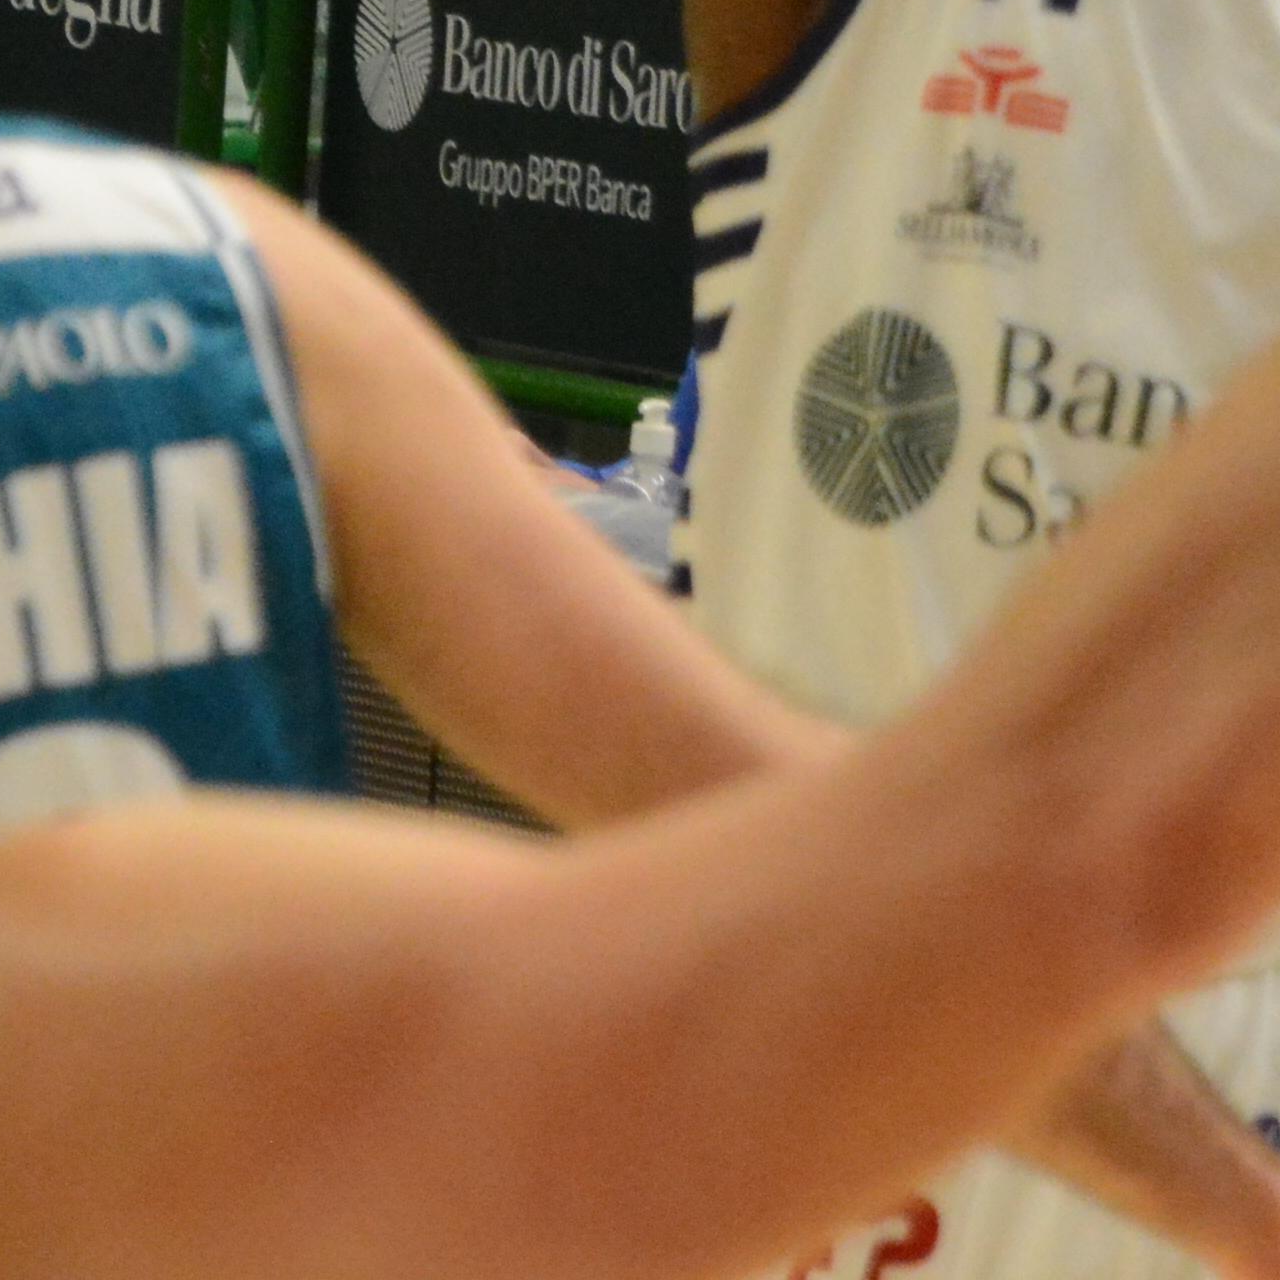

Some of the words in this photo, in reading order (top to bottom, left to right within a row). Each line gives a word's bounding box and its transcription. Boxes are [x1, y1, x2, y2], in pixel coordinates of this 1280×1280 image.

[442, 13, 561, 111] Banco
[568, 35, 604, 118] di
[439, 139, 524, 208] Gruppo
[526, 154, 583, 209] BPER
[585, 164, 653, 221] Banca
[992, 322, 1192, 449] Ban
